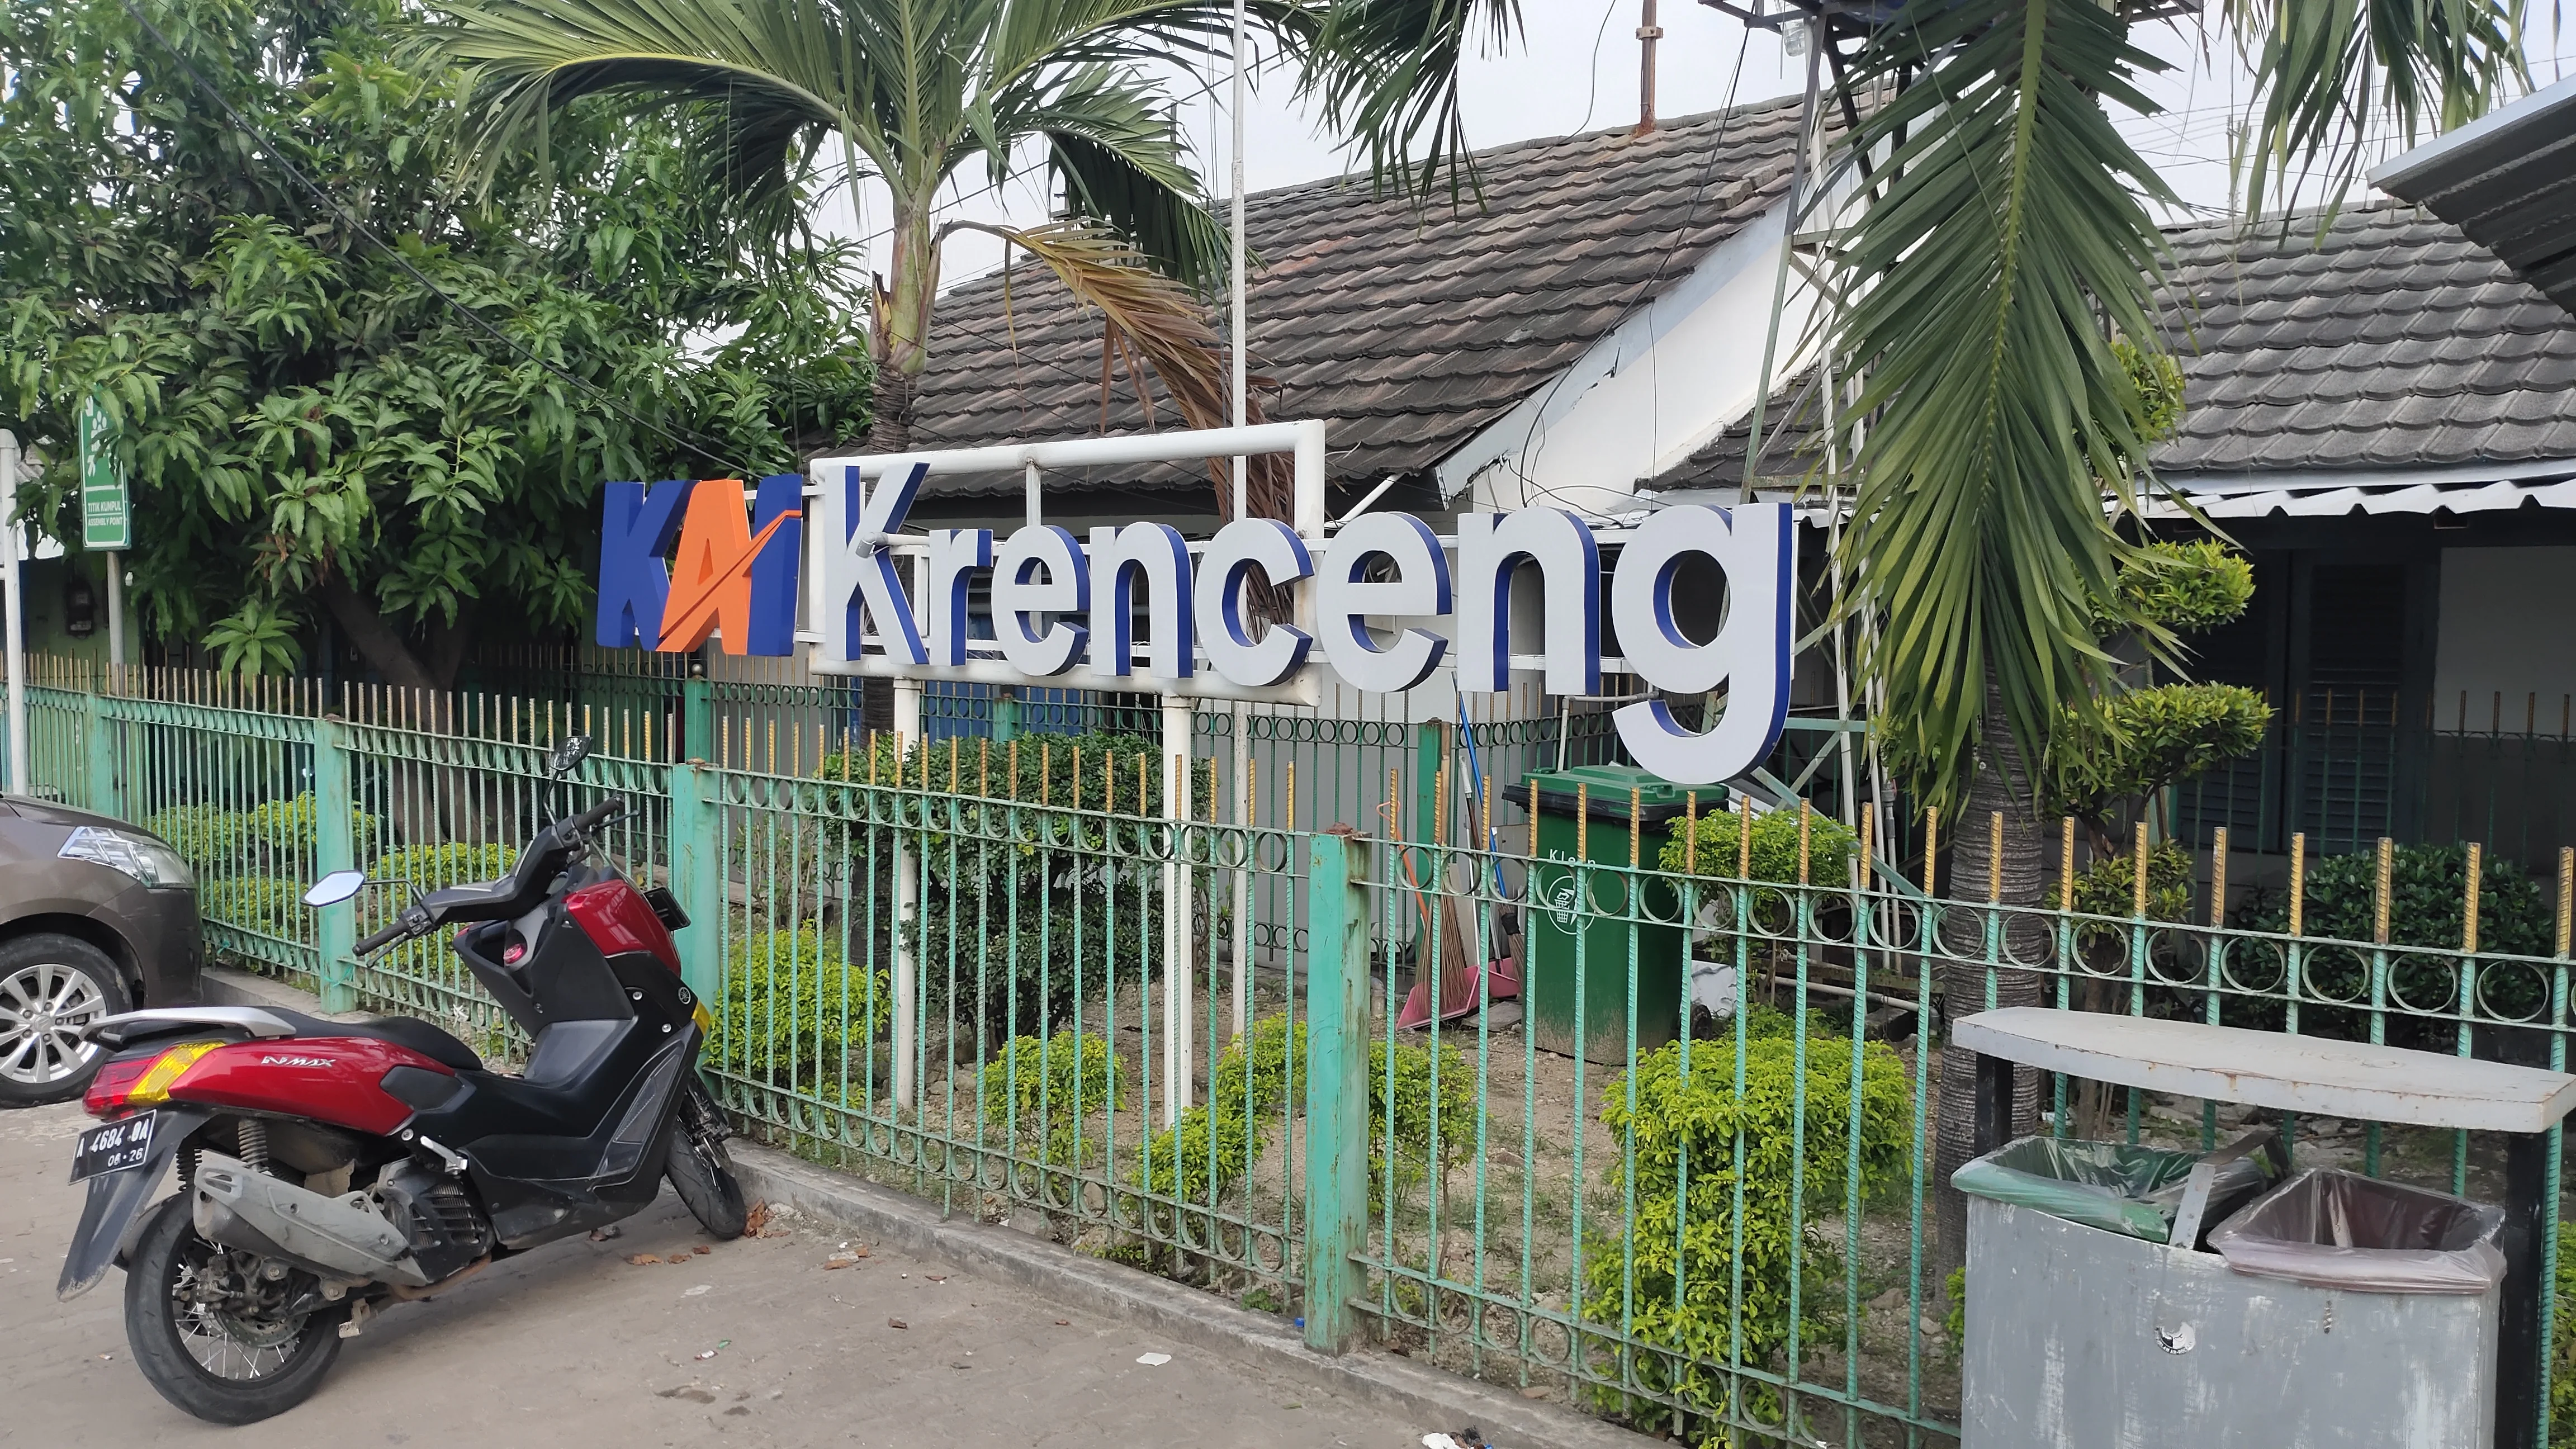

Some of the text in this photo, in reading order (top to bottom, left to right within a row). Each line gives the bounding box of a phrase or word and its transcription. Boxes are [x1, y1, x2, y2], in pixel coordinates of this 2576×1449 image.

[88, 500, 121, 513] TITIK KUMPUL
[88, 517, 123, 527] ASSEMBLY POINT
[596, 462, 1793, 785] KAI Krenceng
[1550, 849, 1596, 870] Klen
[261, 1055, 337, 1067] NMAX
[77, 1137, 85, 1158] A
[91, 1125, 126, 1153] 4684
